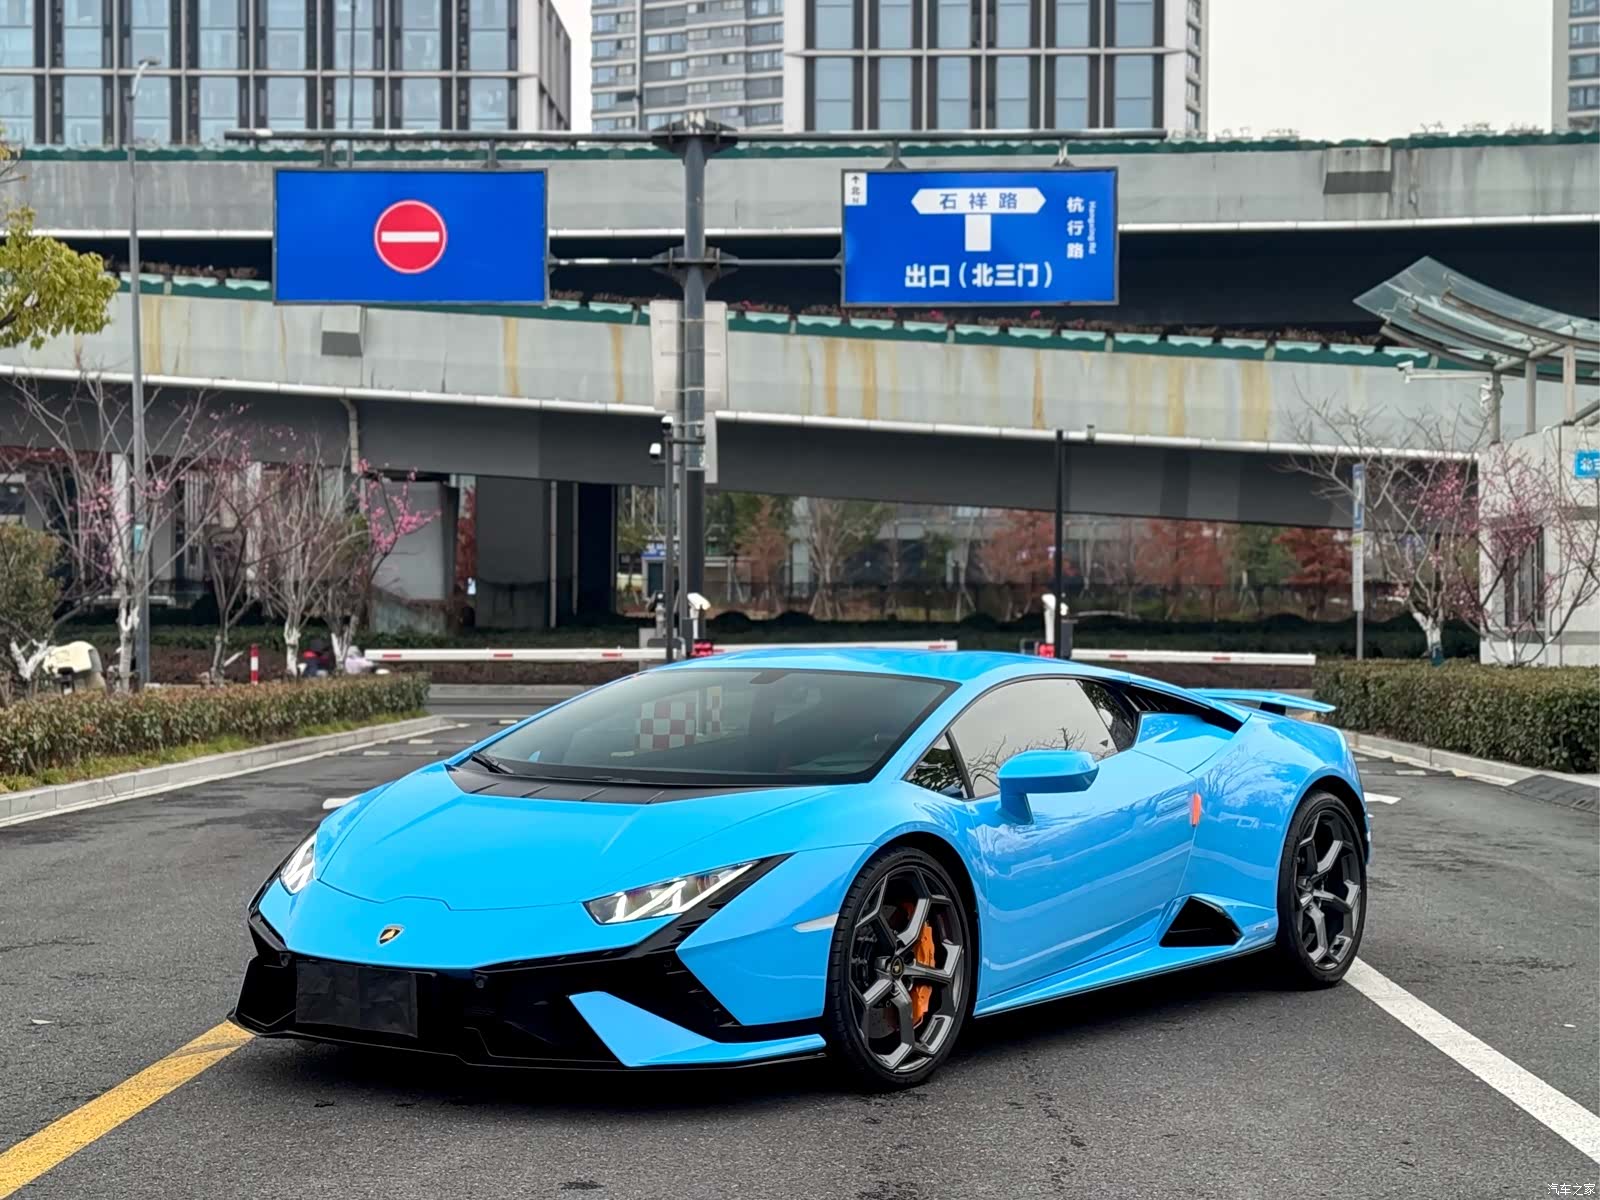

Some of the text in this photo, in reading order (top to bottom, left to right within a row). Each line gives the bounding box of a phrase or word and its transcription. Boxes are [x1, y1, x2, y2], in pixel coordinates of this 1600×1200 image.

[939, 192, 1018, 210] 石祥路
[1066, 196, 1085, 259] 杭行路
